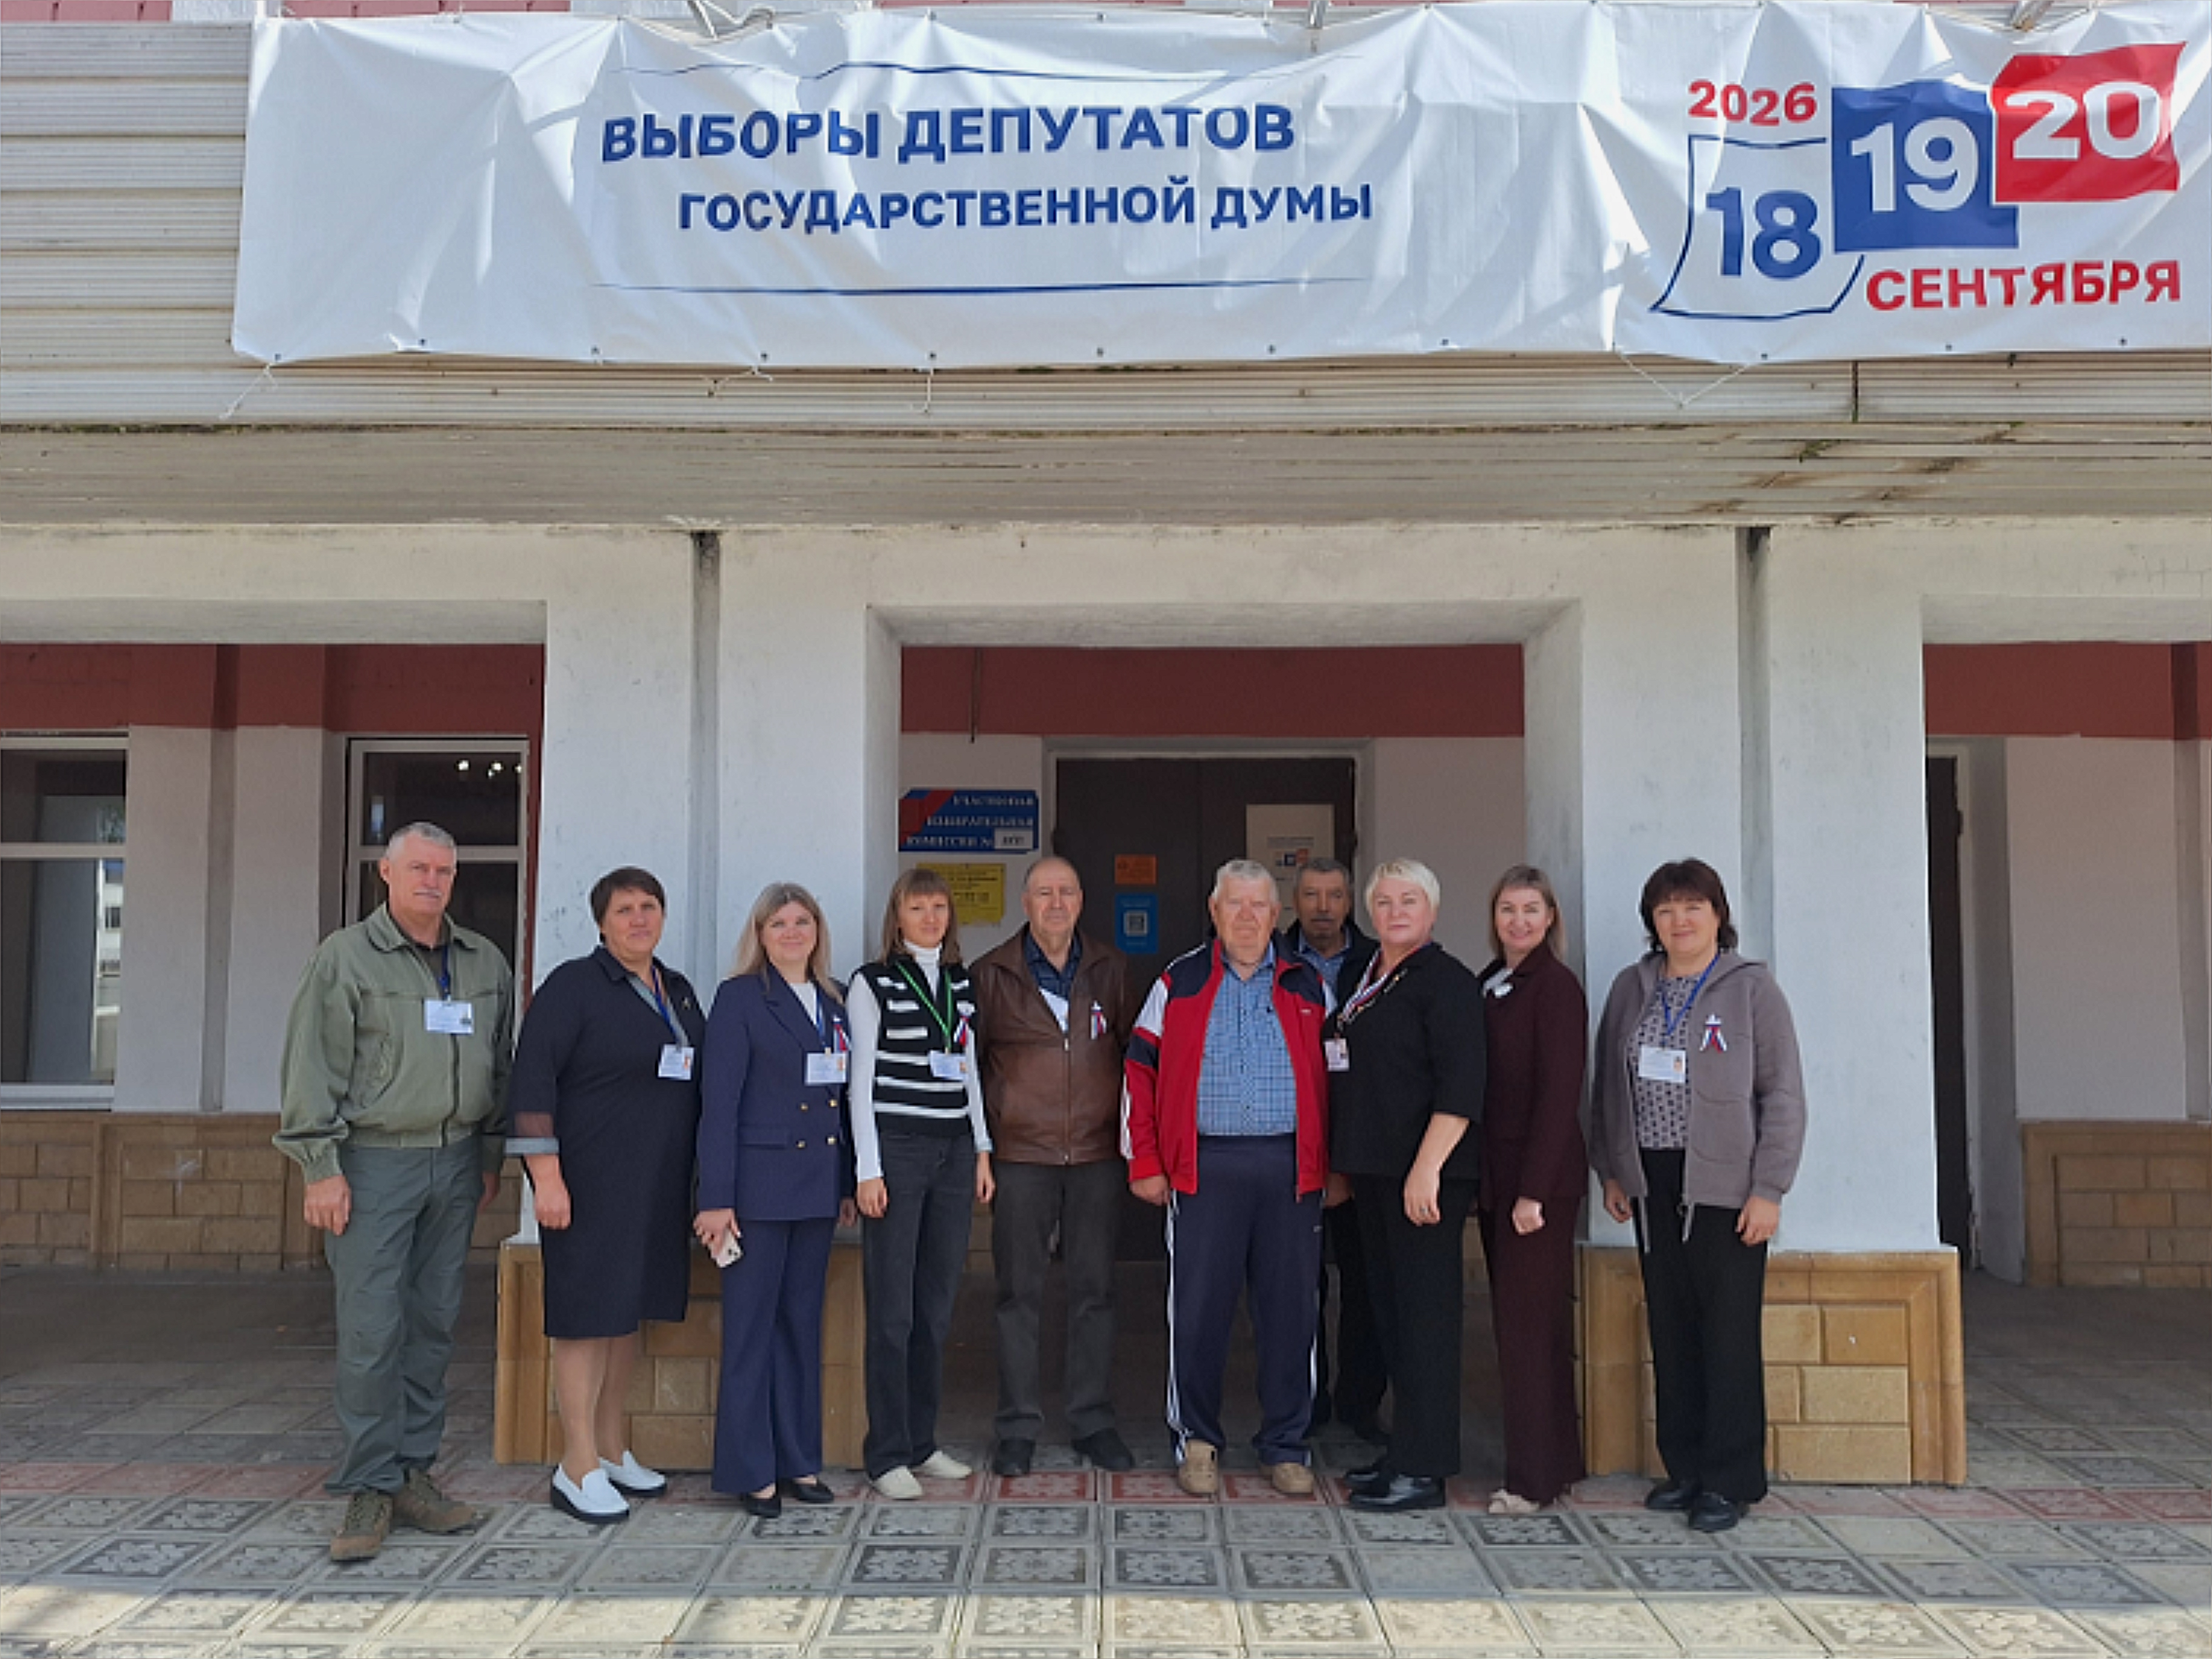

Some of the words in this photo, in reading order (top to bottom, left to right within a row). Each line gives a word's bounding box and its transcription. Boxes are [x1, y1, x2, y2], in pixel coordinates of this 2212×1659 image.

[1688, 80, 1817, 126] 2026
[2006, 82, 2160, 160] 20
[602, 109, 879, 162] ВЫБОРЫ
[898, 104, 1295, 163] ДЕПУТАТОВ
[1851, 118, 1978, 211] 19
[680, 175, 1195, 234] ГОСУДАРСТВЕННОЙ
[1211, 183, 1372, 230] ДУМЫ
[1706, 186, 1821, 280] 18
[1867, 260, 2180, 310] СЕНТЯБРЯ
